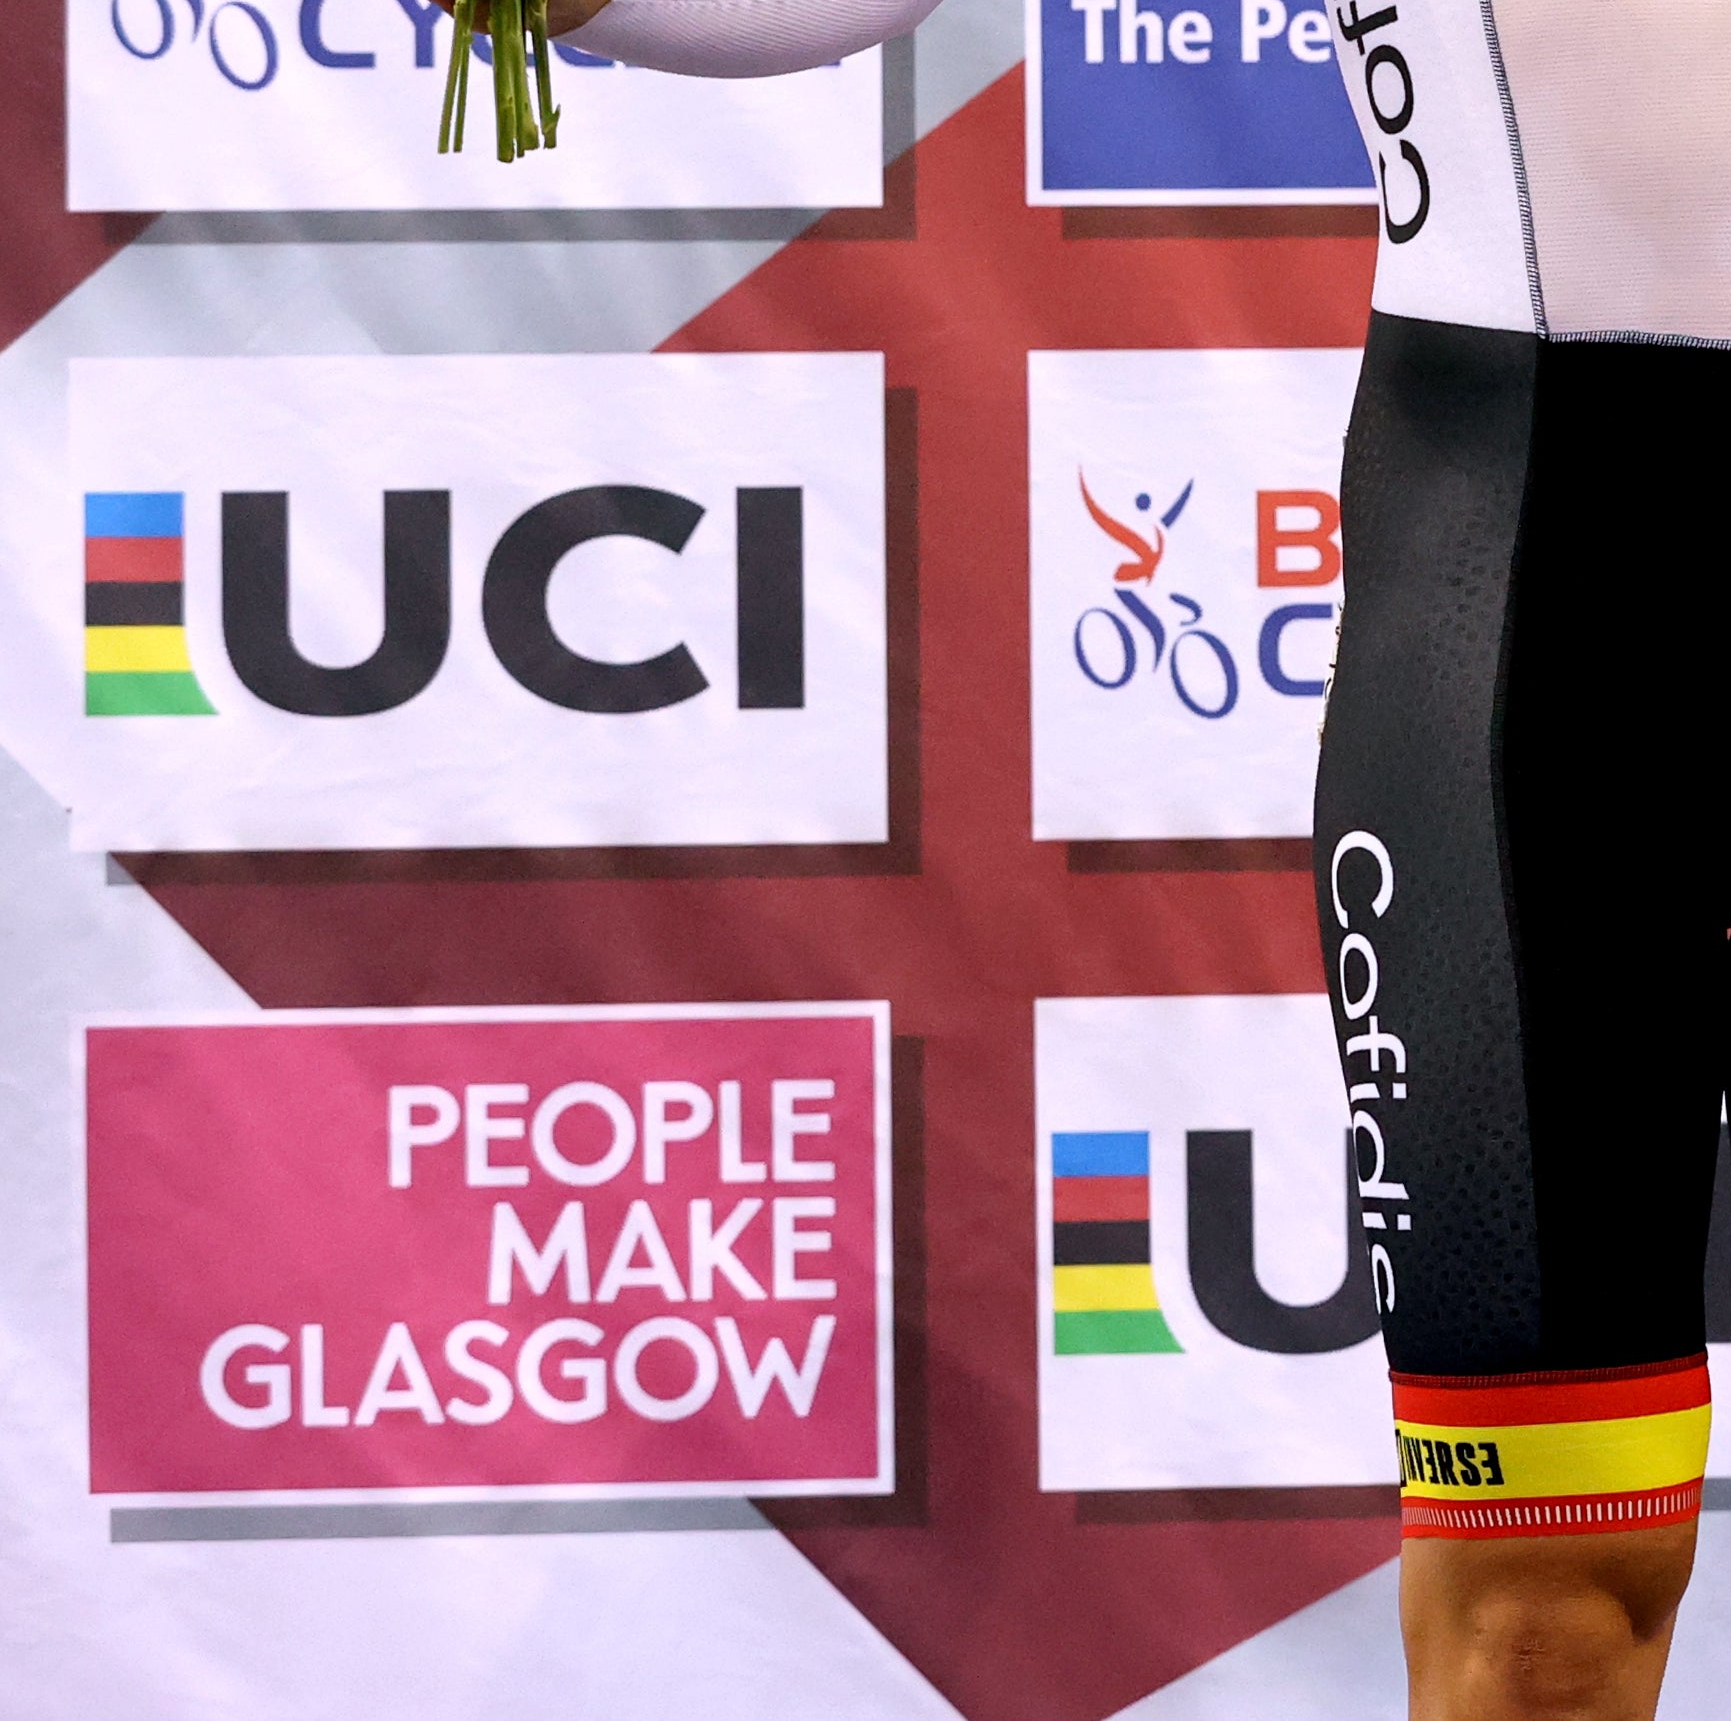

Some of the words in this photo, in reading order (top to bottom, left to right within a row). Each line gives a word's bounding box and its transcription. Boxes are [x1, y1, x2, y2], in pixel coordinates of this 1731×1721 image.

[222, 484, 804, 717] UCI
[388, 1079, 836, 1189] PEOPLE
[487, 1195, 837, 1306] MAKE
[200, 1313, 837, 1431] GLASGOW
